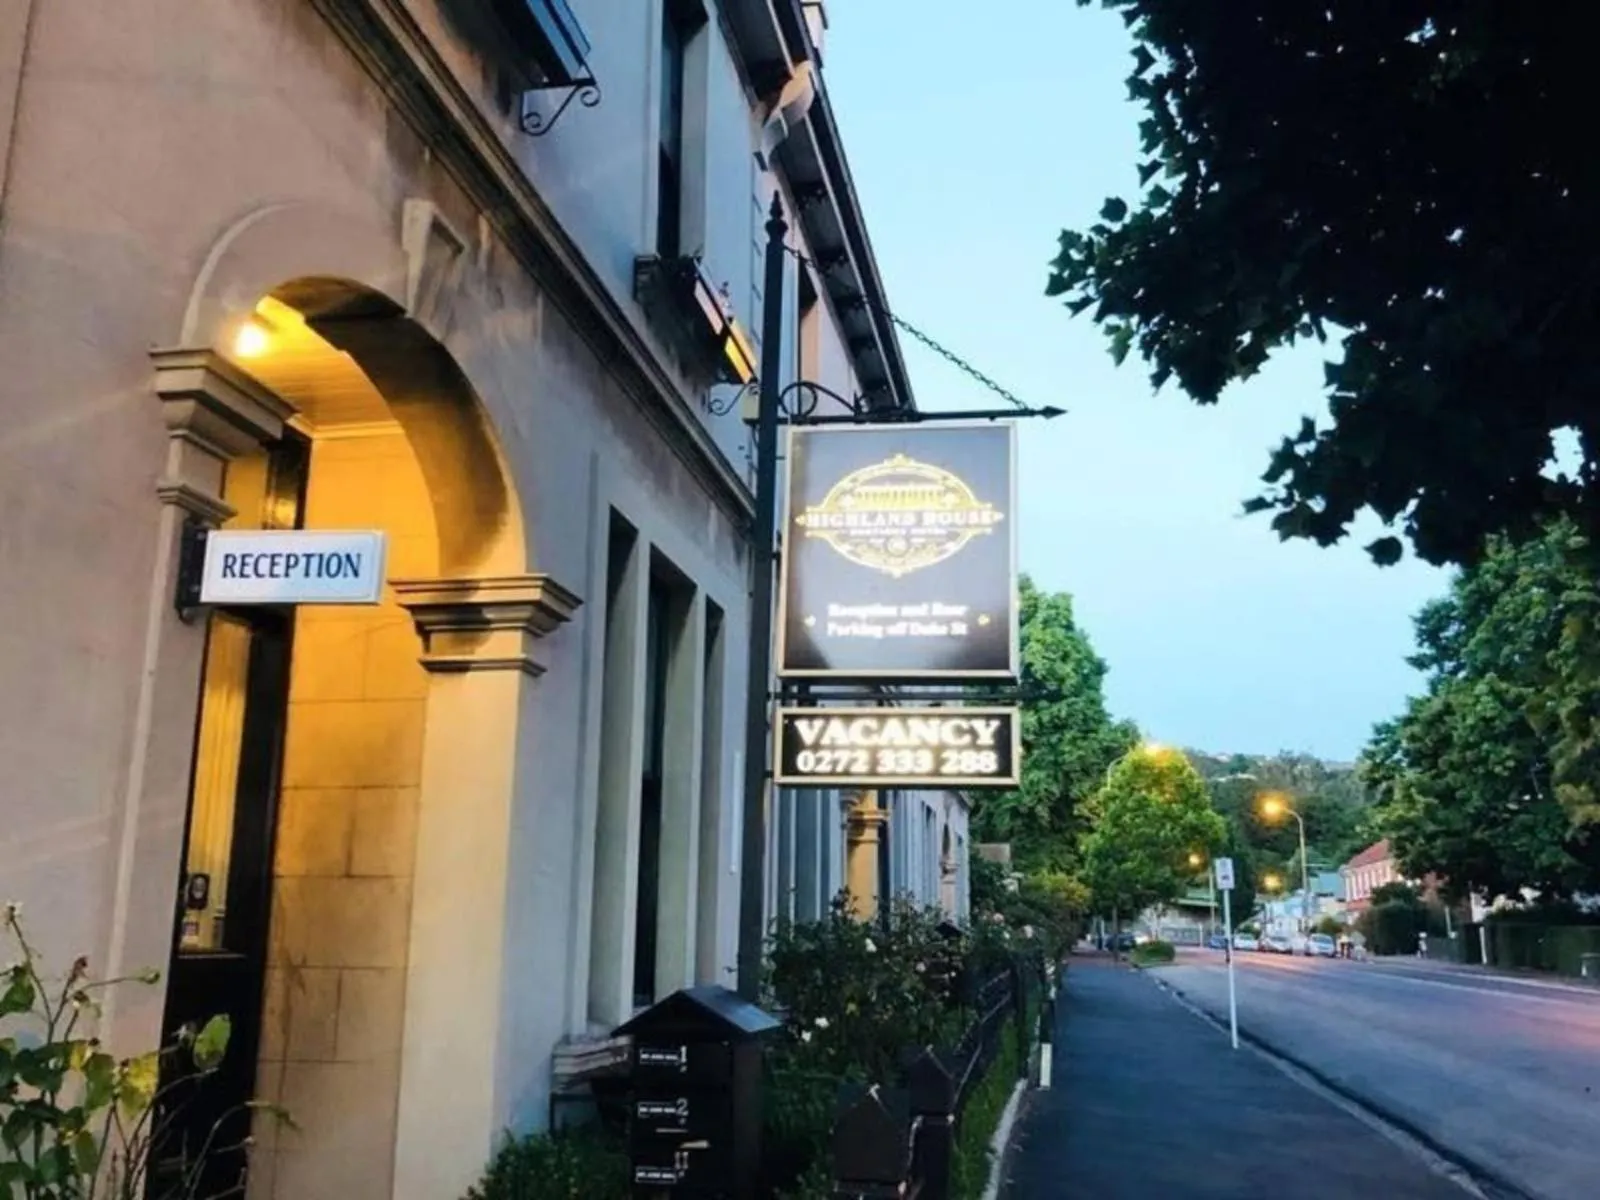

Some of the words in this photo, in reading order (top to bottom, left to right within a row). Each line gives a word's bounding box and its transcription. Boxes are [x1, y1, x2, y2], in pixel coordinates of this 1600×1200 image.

[221, 553, 362, 579] RECEPTION
[827, 622, 883, 638] Parking
[795, 717, 999, 746] VACANCY
[796, 750, 869, 773] 0272
[876, 749, 933, 774] 333
[676, 1098, 689, 1116] 2
